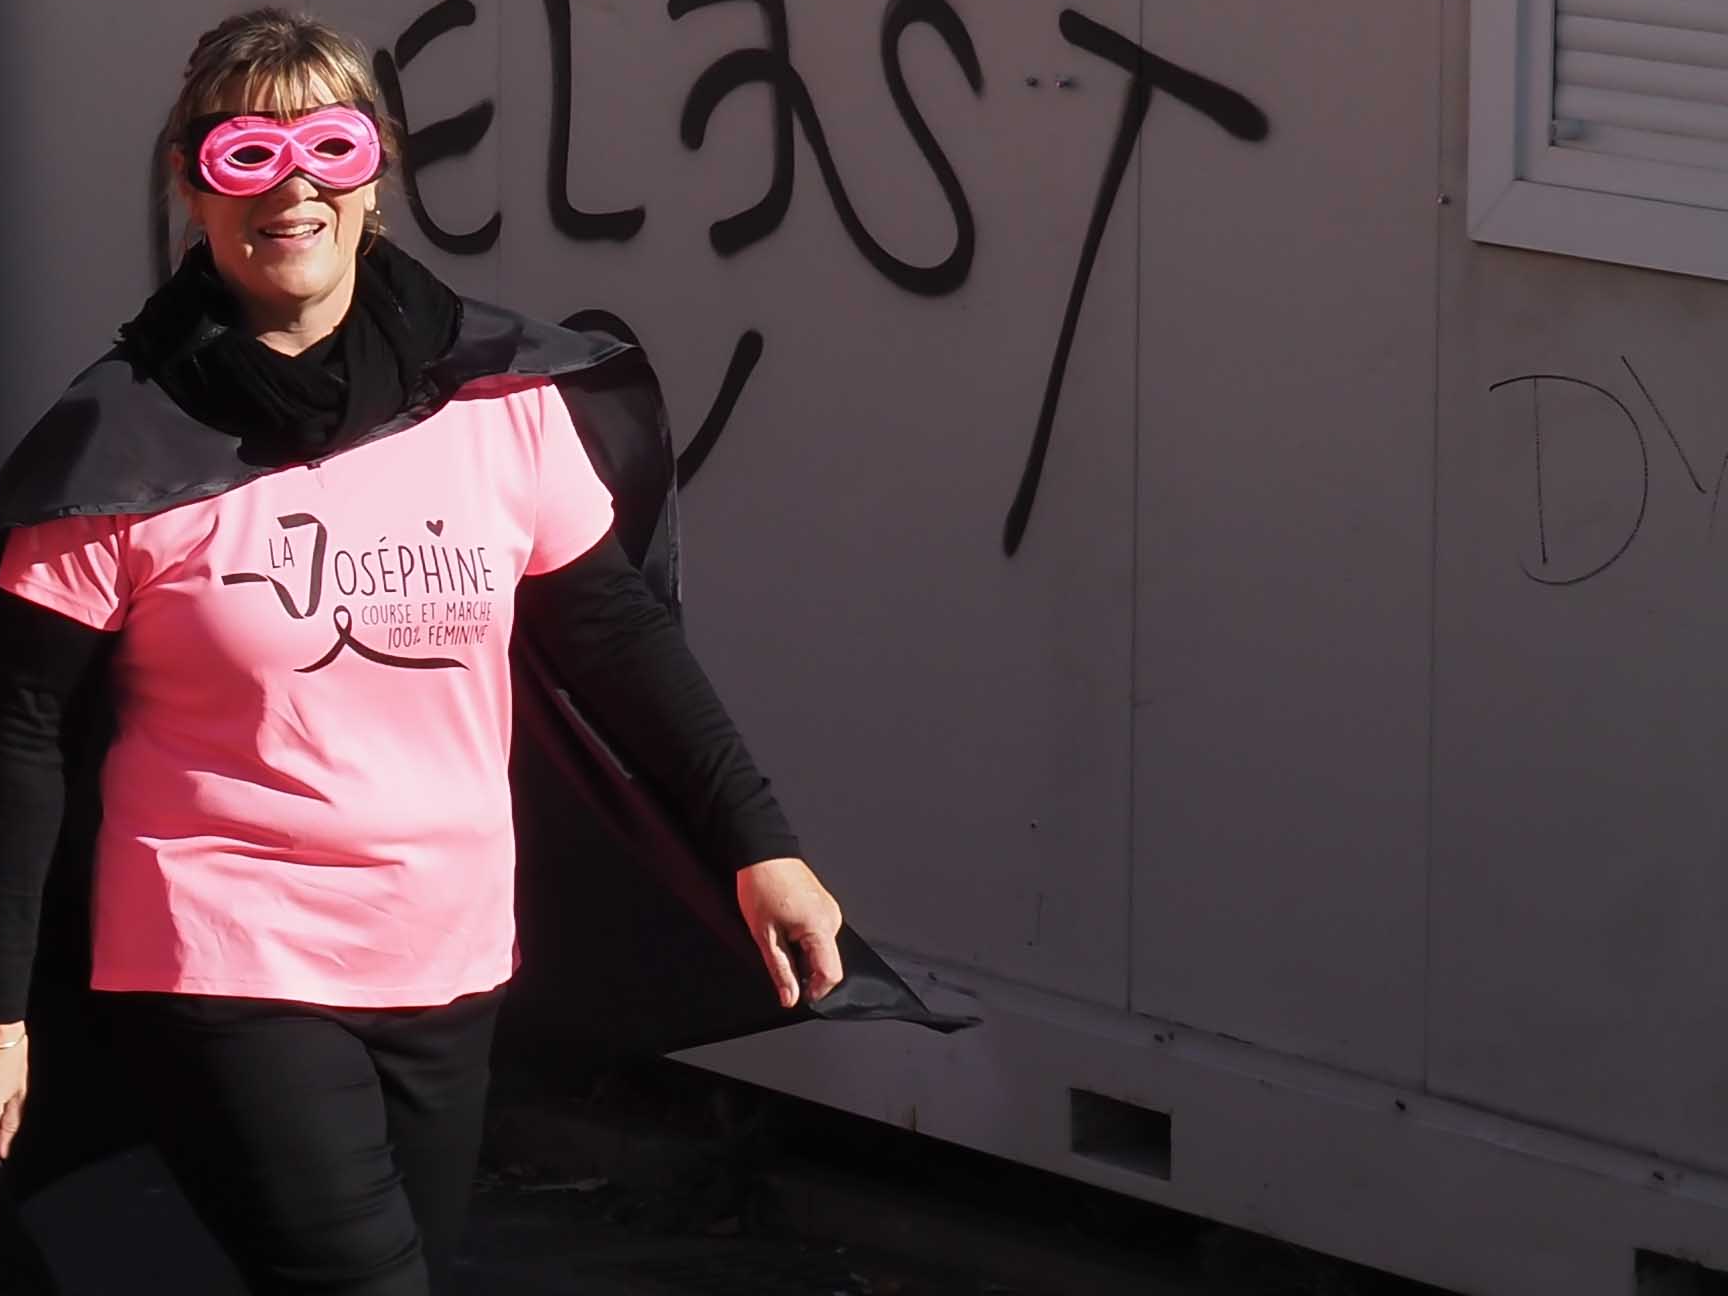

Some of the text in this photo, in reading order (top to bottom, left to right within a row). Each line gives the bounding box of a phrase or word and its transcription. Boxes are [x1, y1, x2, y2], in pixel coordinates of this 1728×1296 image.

[221, 512, 495, 619] LA JOSÉPHINE
[360, 600, 493, 625] COURSE ET MARCHE
[387, 621, 490, 649] 100% FÉMININE
